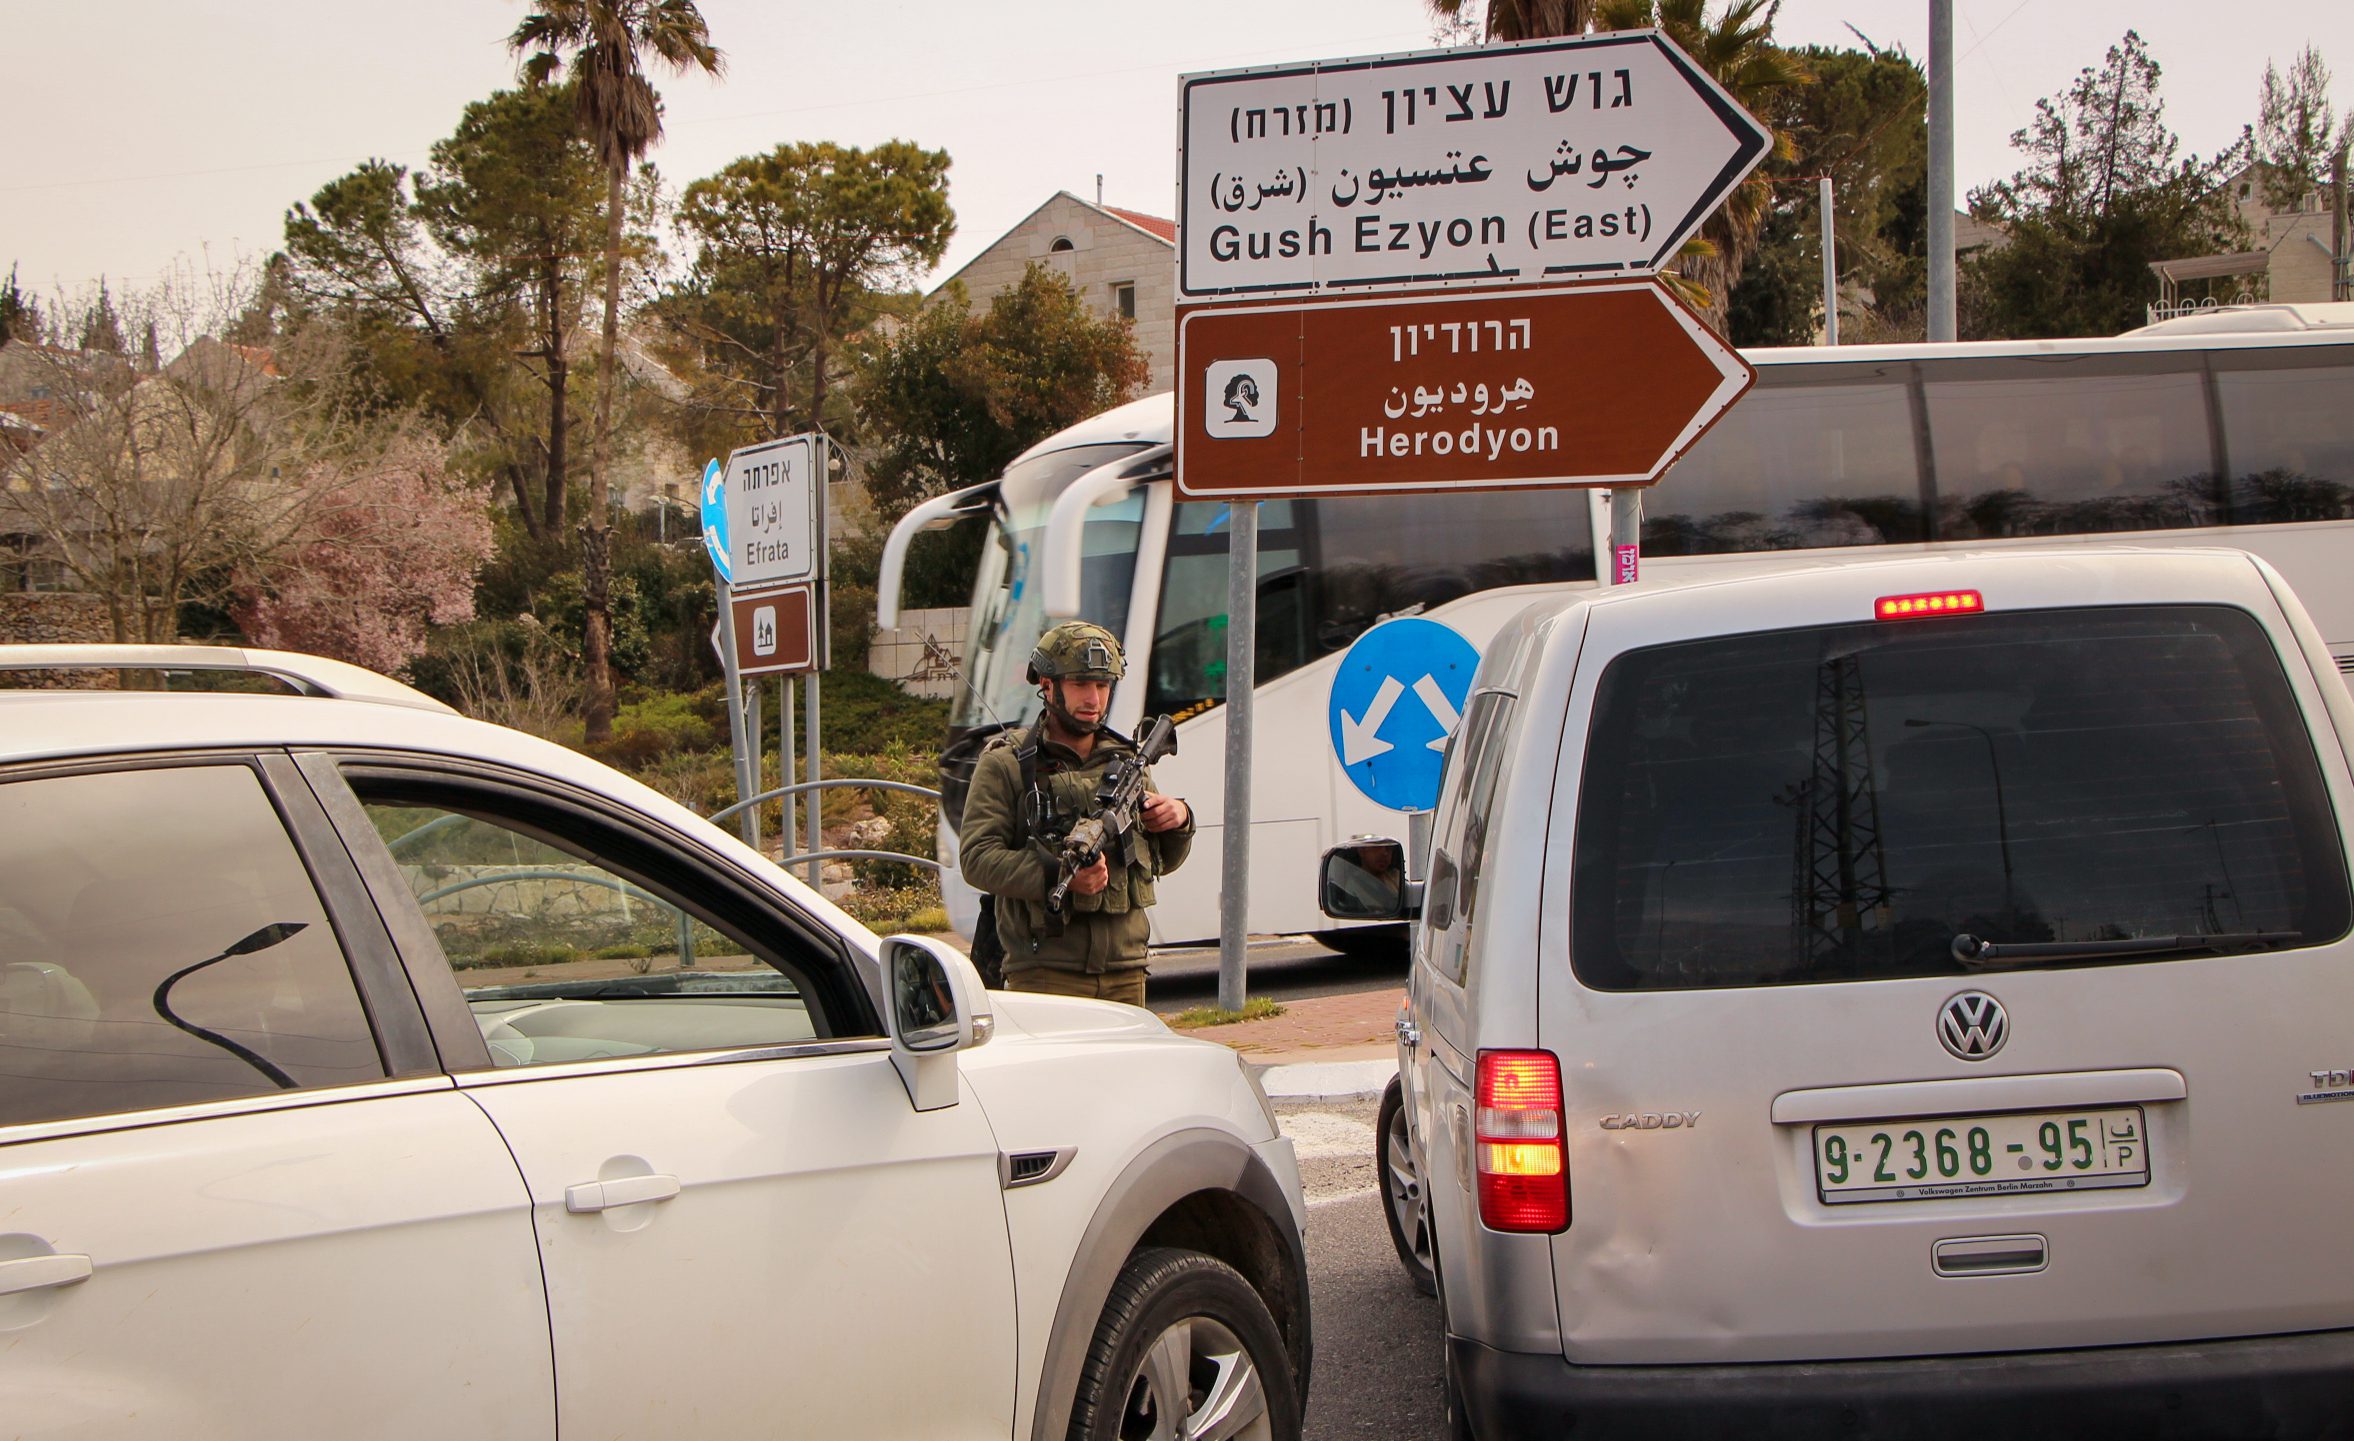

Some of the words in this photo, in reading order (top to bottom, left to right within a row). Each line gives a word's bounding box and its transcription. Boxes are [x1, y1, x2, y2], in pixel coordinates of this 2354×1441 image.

[1381, 79, 1511, 135] עציון
[1543, 68, 1633, 114] גוש
[1230, 97, 1352, 144] (מזרח)
[1210, 166, 1307, 213] (شرق)
[1331, 150, 1493, 208] عتسيون
[1209, 219, 1332, 263] Gush
[1354, 214, 1505, 260] Ezyon
[1528, 203, 1652, 250] (East)
[1390, 318, 1531, 362] הרודיון
[1360, 422, 1558, 461] Herodyon
[742, 459, 791, 492] אפרתה
[746, 541, 789, 566] Efrata
[1599, 1111, 1702, 1130] CADDY
[1918, 1187, 1964, 1196] Volkswagen
[1965, 1184, 1996, 1193] Zentrum
[1997, 1181, 2019, 1191] Berlin
[2020, 1181, 2053, 1190] Marzahn
